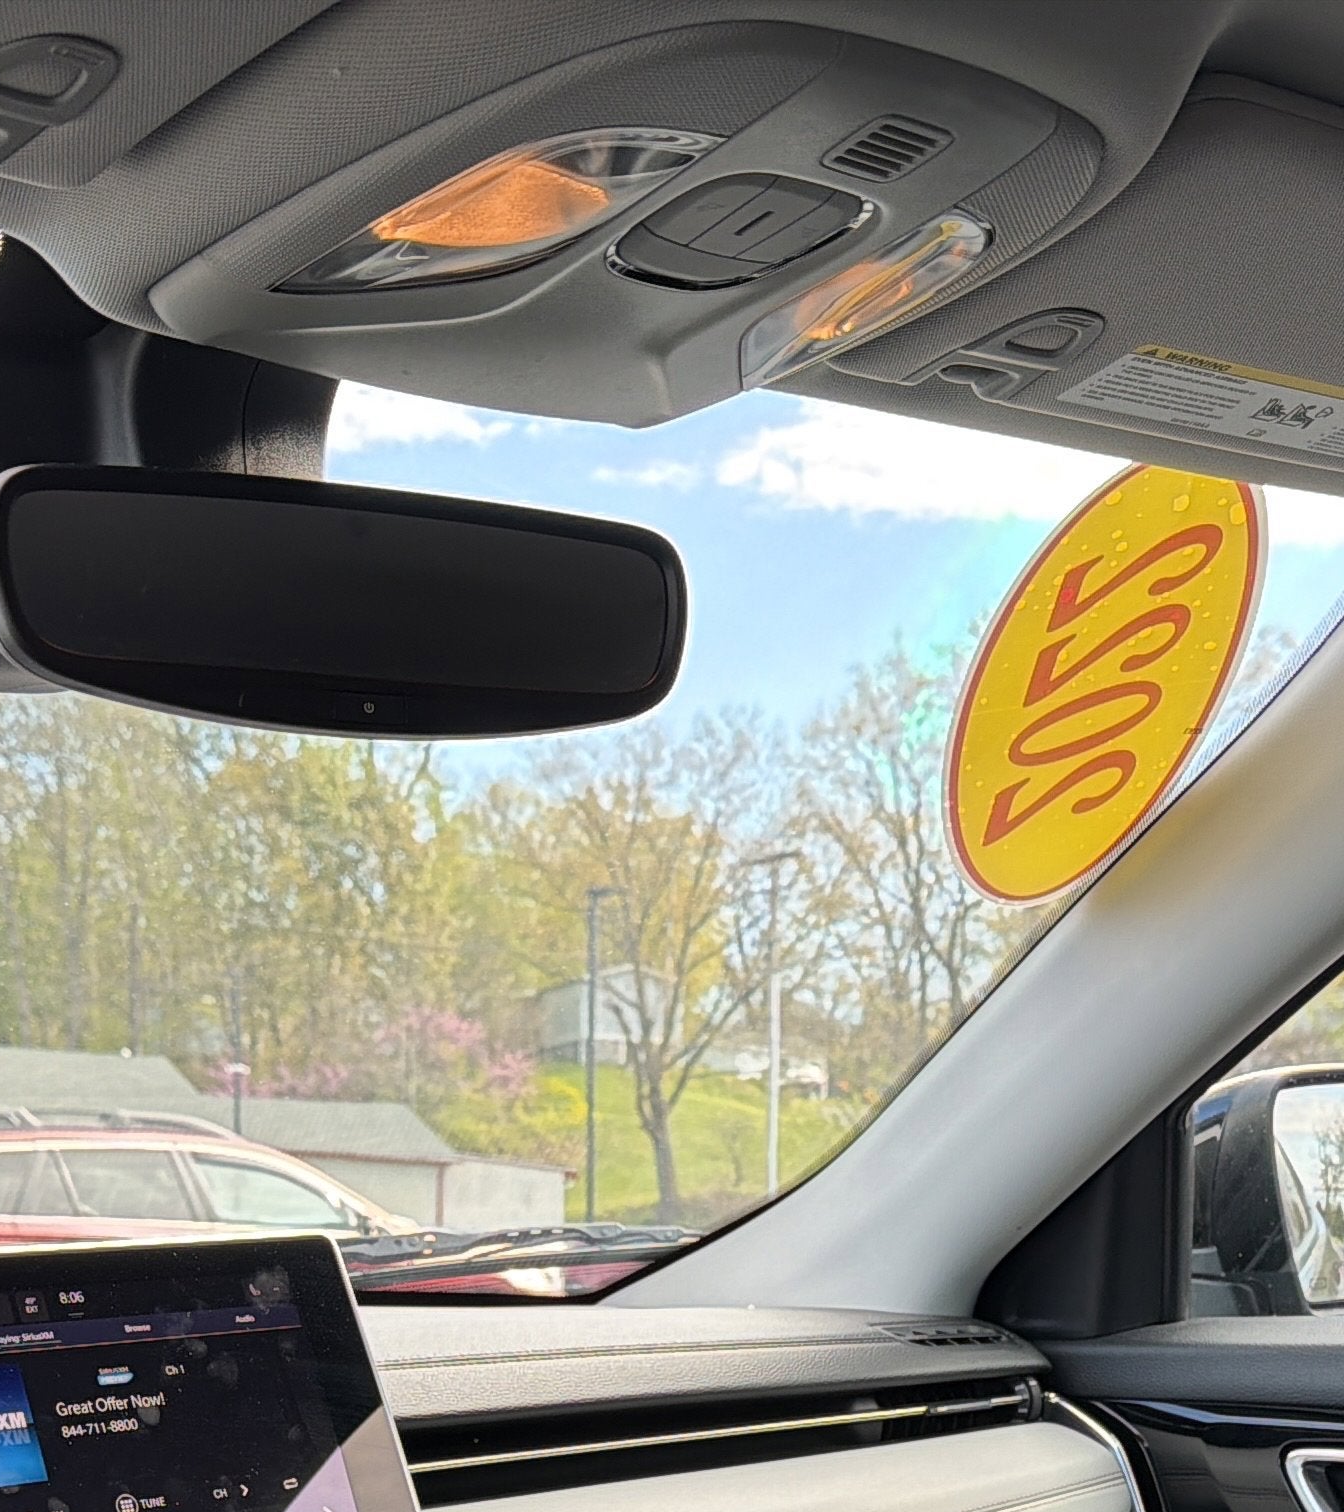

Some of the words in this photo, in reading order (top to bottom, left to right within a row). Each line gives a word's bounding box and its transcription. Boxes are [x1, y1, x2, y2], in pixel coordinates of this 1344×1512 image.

[1165, 351, 1233, 373] WARNING
[58, 1291, 85, 1304] 8:06
[25, 1305, 39, 1314] EXT
[235, 1314, 256, 1323] Audio
[123, 1323, 151, 1333] Browse
[21, 1331, 55, 1343] SiriusXM
[165, 1365, 179, 1375] Ch
[56, 1402, 94, 1417] Great
[95, 1396, 131, 1412] Offer
[132, 1392, 166, 1408] Now!
[61, 1418, 139, 1438] 844-711-8800
[213, 1488, 228, 1500] CH
[139, 1496, 166, 1509] TUNE
